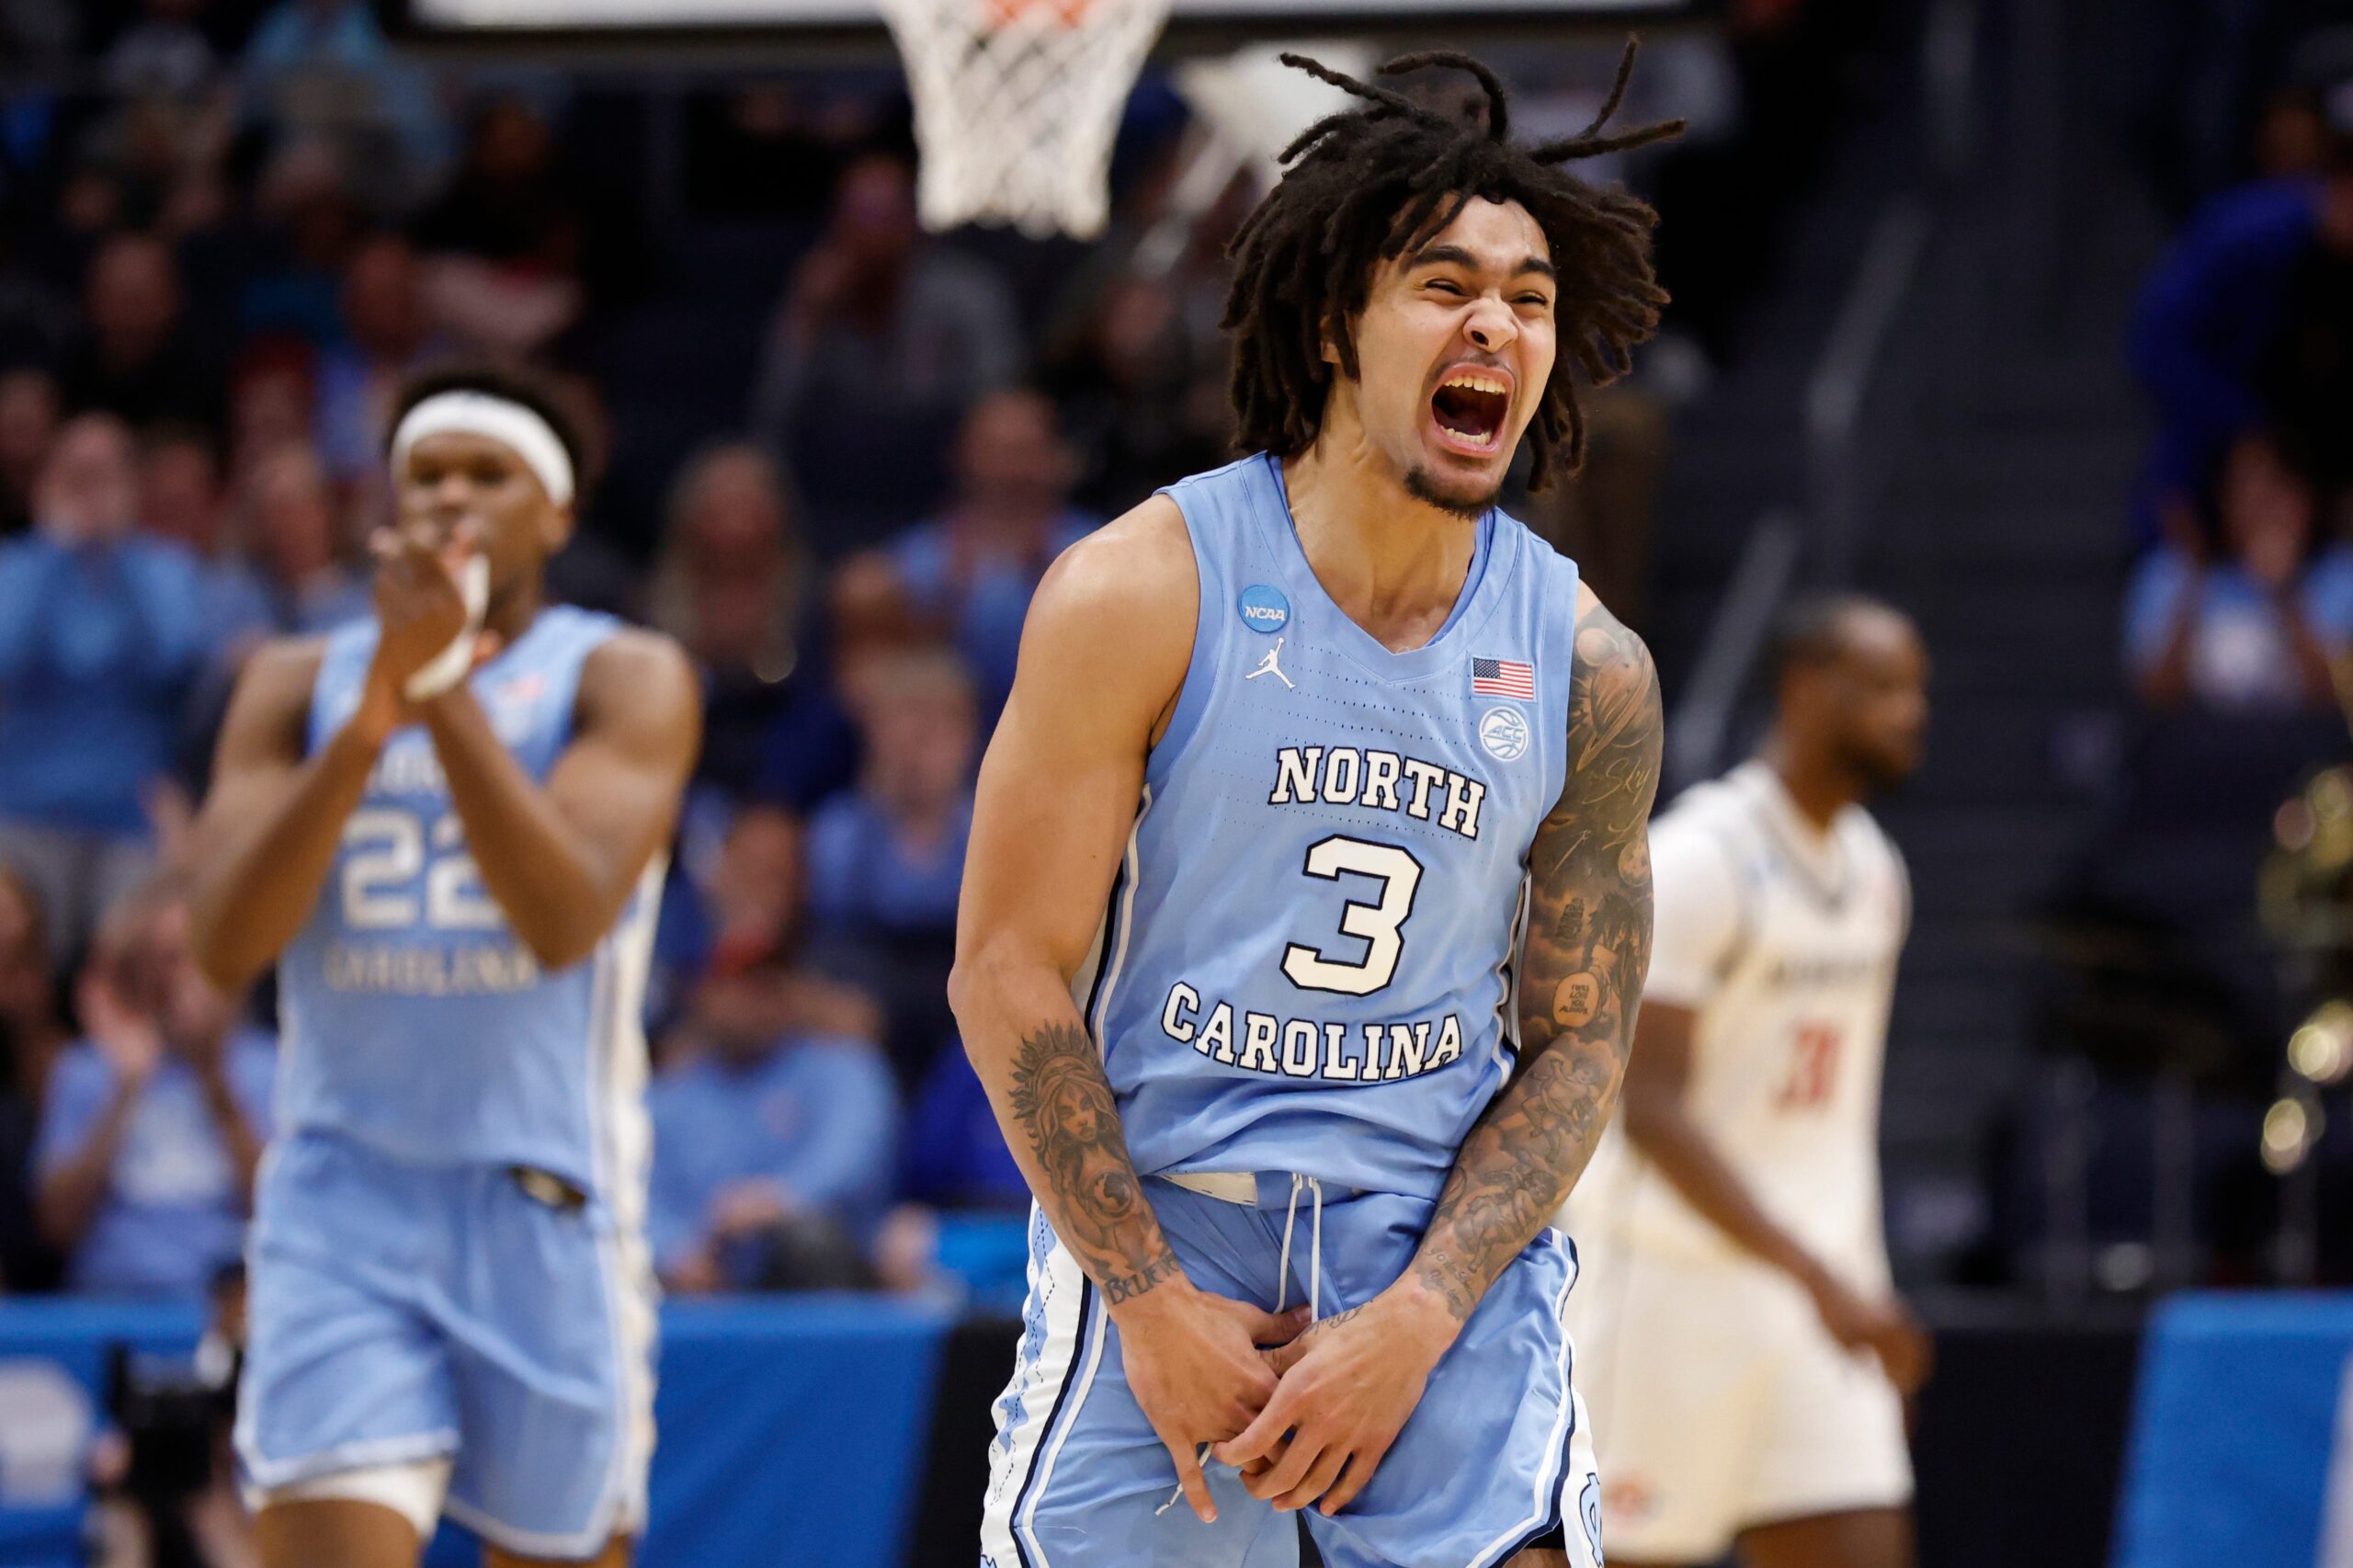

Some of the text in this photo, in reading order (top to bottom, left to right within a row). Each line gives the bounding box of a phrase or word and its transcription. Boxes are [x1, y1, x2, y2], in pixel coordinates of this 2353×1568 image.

[1245, 605, 1286, 622] NCAA
[1486, 724, 1524, 743] ACC
[1267, 744, 1487, 840] NORTH
[1279, 833, 1424, 997] 3
[1161, 980, 1463, 1083] CAROLINA
